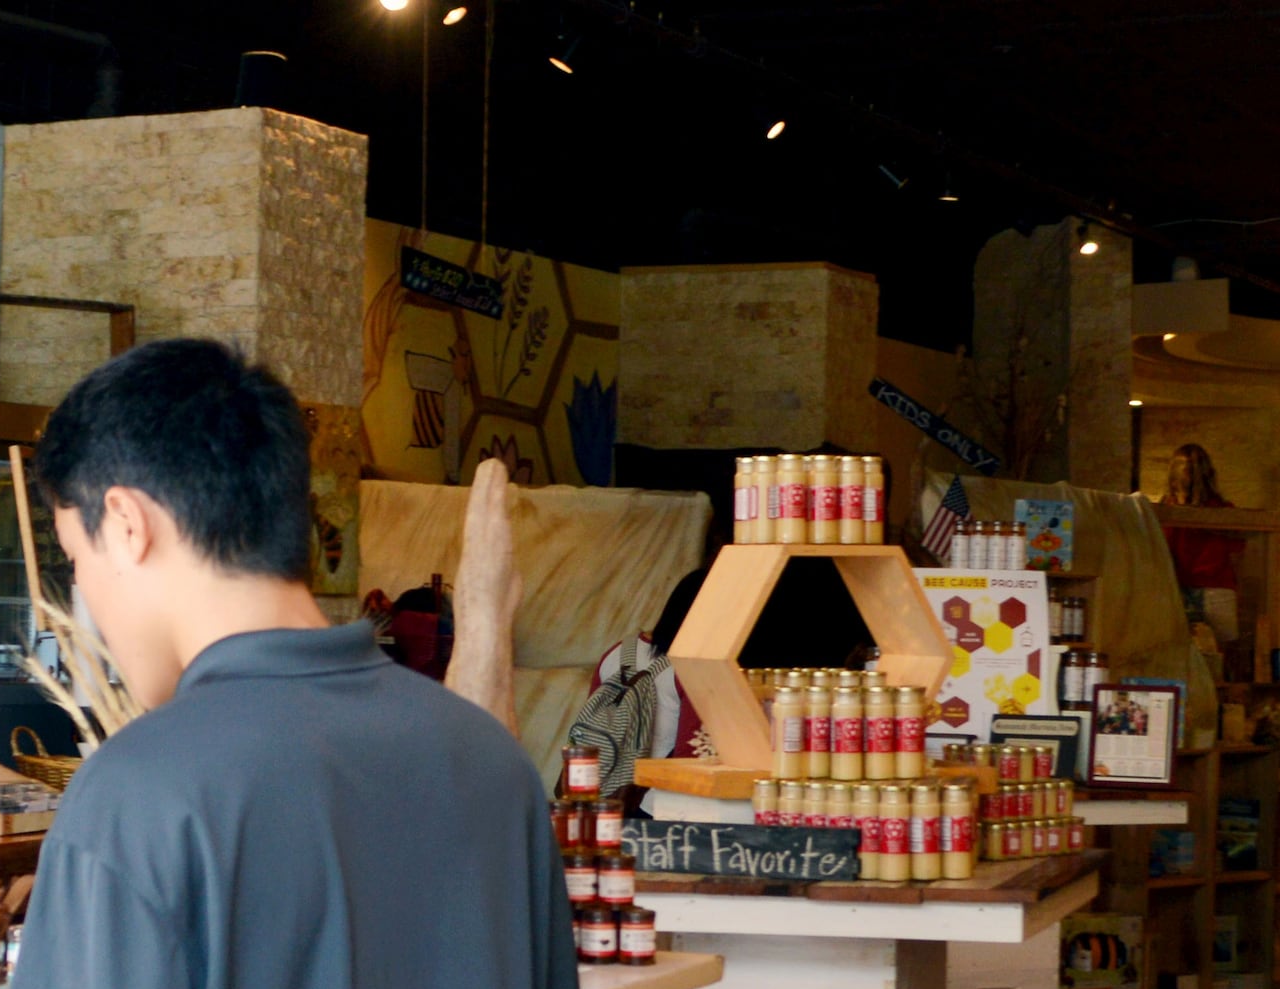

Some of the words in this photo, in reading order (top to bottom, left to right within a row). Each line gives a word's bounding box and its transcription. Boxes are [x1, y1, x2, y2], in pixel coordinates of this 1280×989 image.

[877, 383, 932, 429] KIDS
[937, 428, 995, 468] ONLY
[924, 577, 946, 589] BEE
[949, 577, 988, 589] CAUSE
[991, 578, 1039, 590] PROJECT
[621, 821, 700, 870] Staff
[711, 826, 848, 878] Favorite
